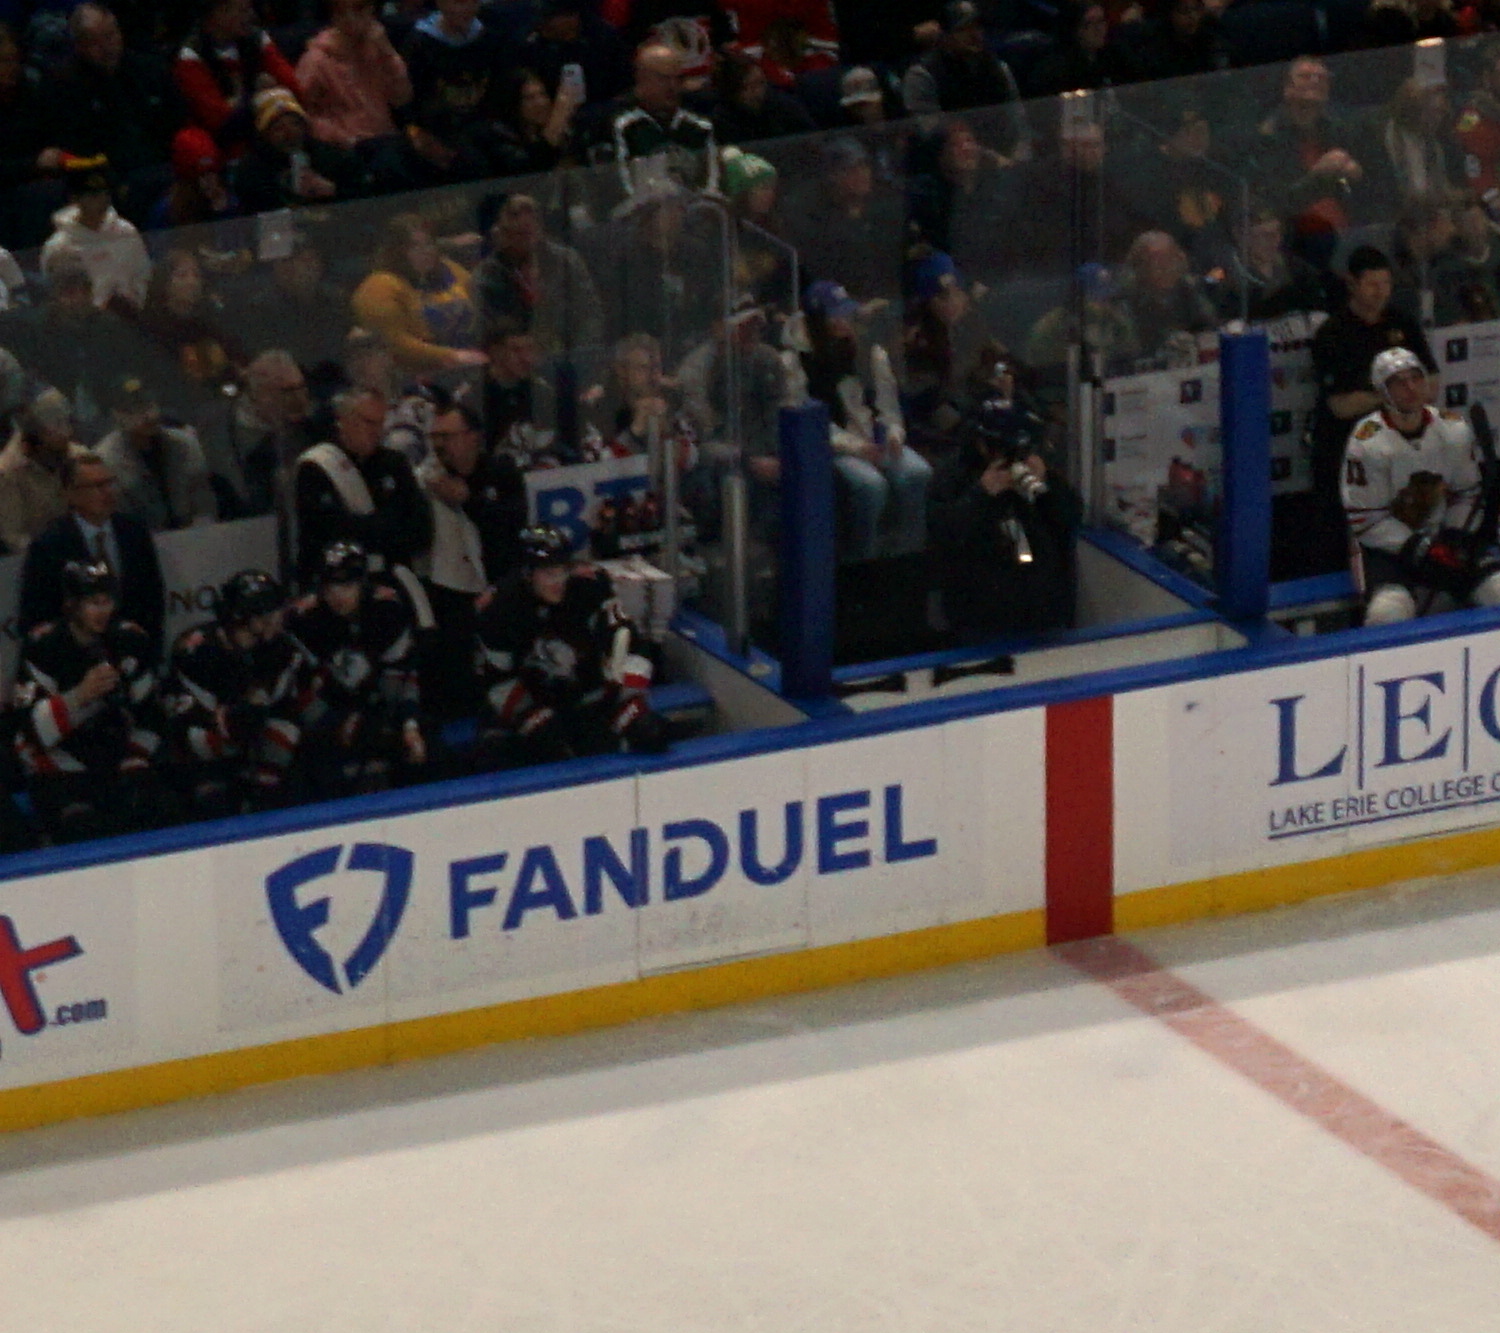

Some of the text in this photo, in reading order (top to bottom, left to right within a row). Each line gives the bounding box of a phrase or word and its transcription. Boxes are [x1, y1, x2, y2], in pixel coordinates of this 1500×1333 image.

[1268, 800, 1325, 832] LAKE
[1331, 794, 1379, 820] ERIE
[1384, 776, 1485, 816] COLLEGE
[447, 784, 938, 940] FANDUEL
